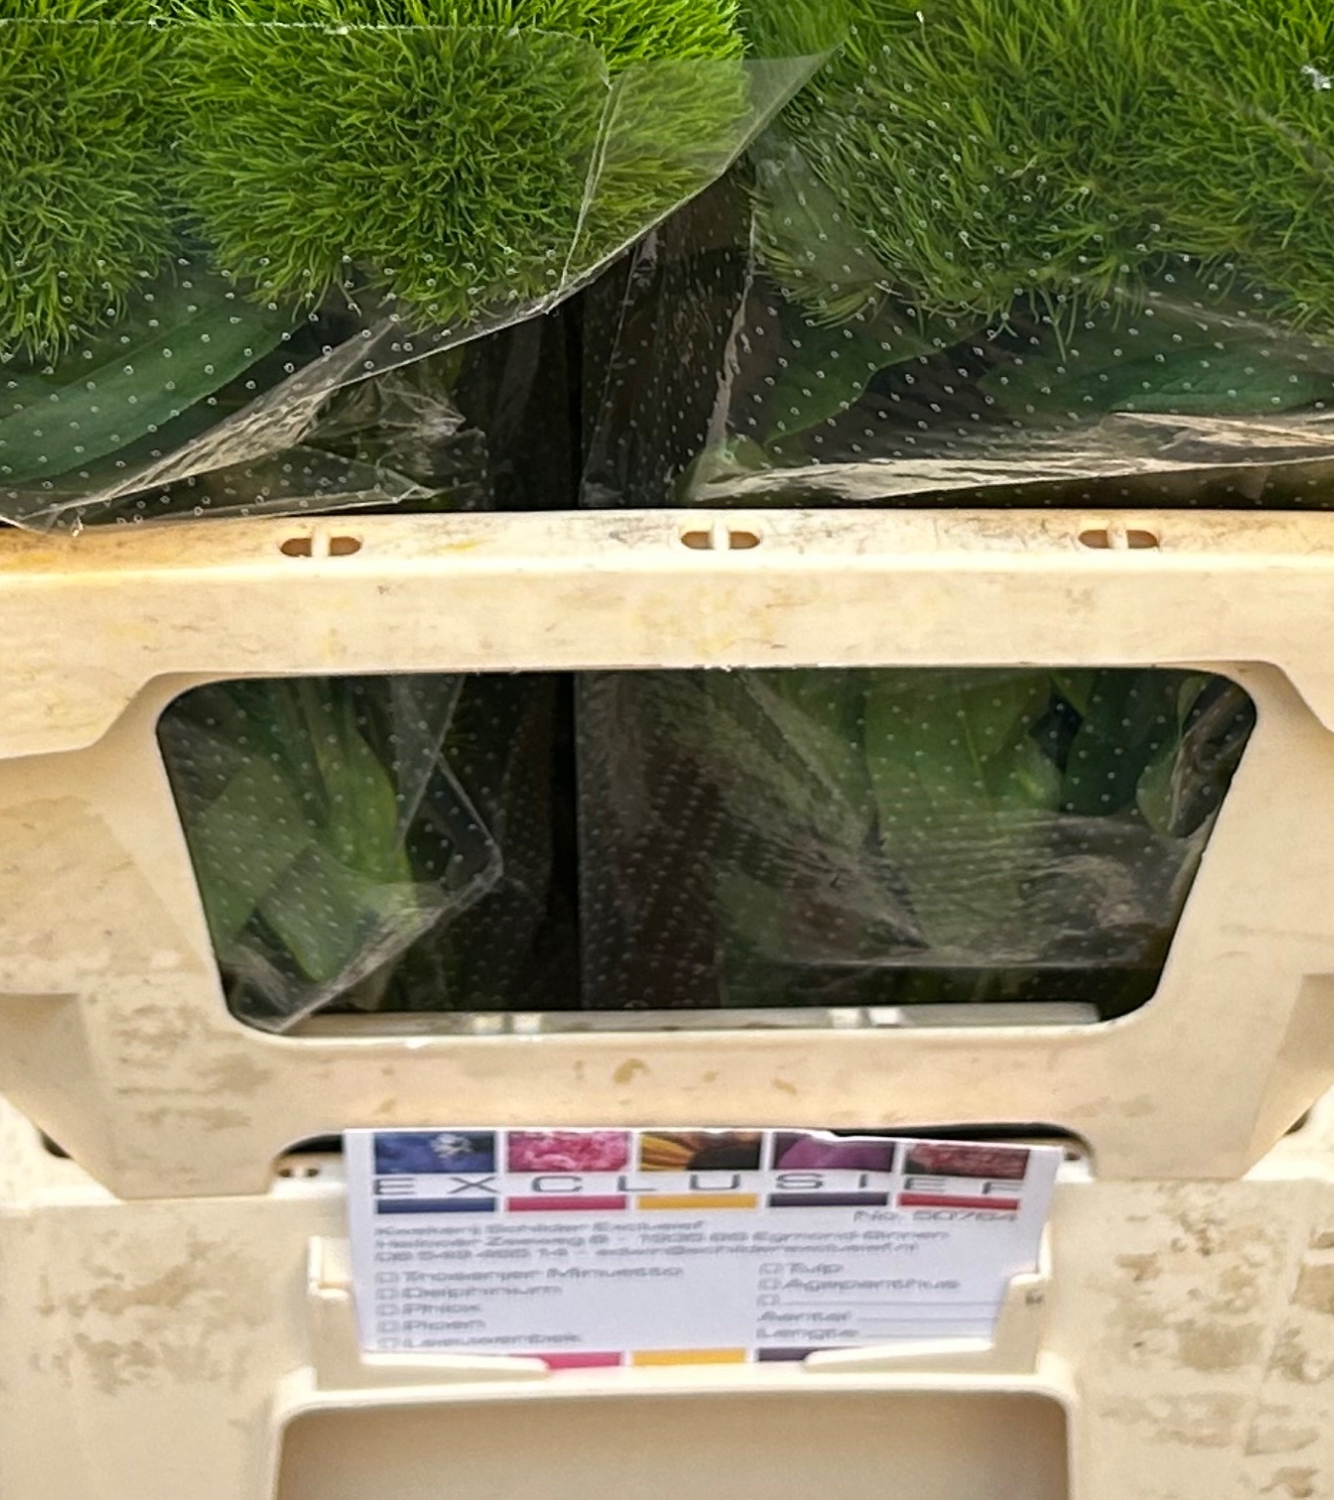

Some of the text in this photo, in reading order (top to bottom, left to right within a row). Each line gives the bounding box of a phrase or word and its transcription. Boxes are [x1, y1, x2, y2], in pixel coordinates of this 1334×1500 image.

[373, 1173, 1024, 1196] EXCLUSIEF
[593, 1220, 705, 1232] Exclusief
[783, 1277, 961, 1292] Agapanthus
[403, 1285, 563, 1299] Delphinium
[402, 1302, 482, 1315] Phlox
[757, 1327, 860, 1341] Lengte
